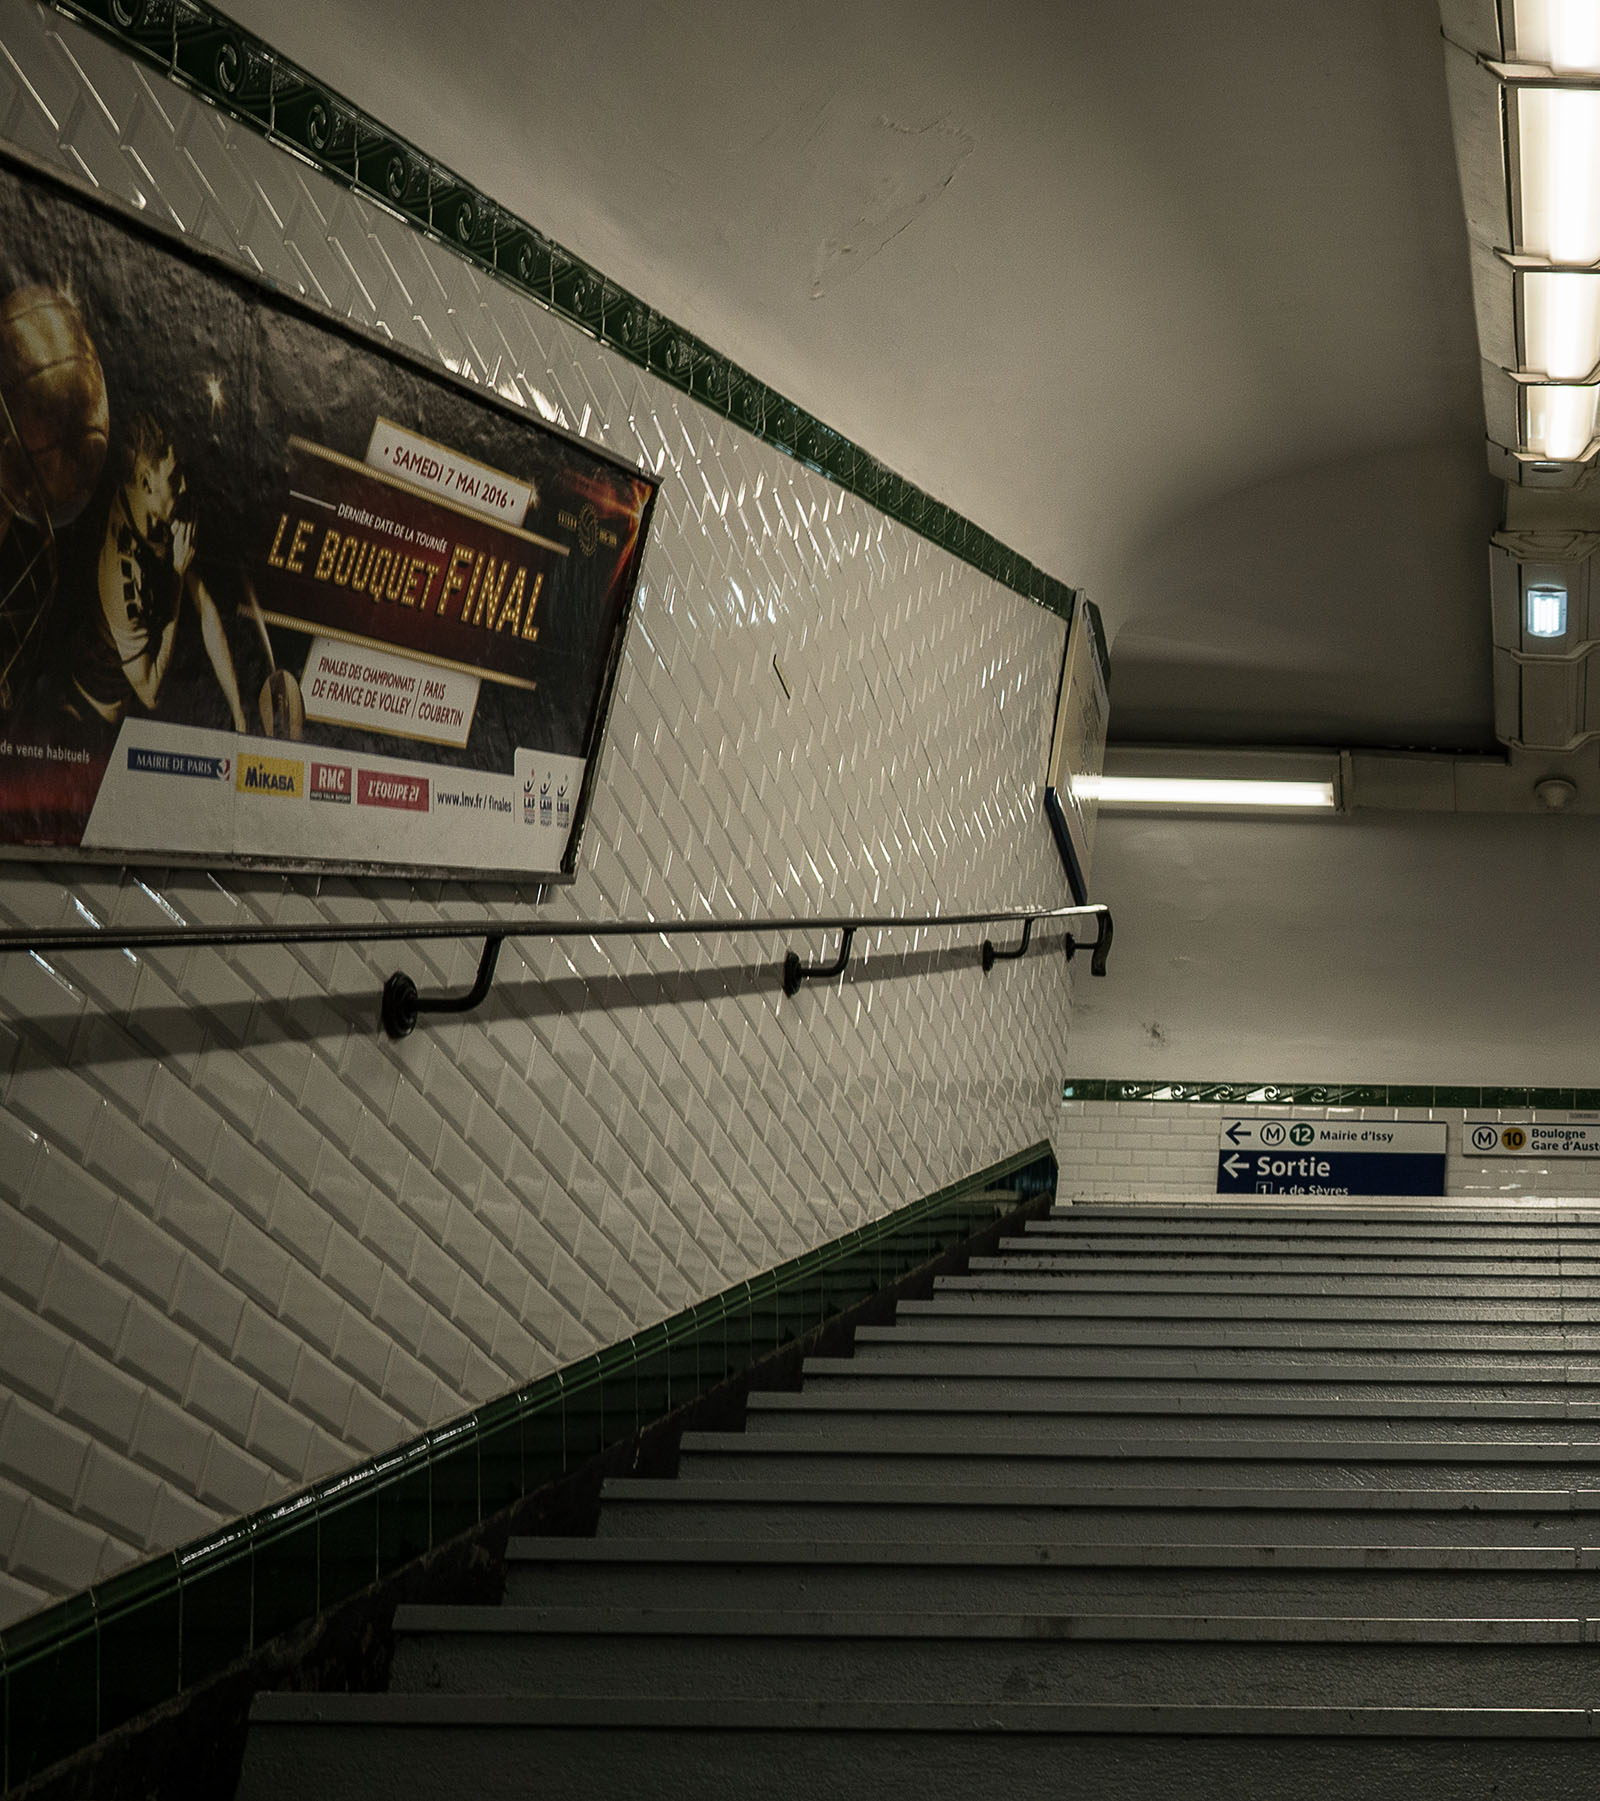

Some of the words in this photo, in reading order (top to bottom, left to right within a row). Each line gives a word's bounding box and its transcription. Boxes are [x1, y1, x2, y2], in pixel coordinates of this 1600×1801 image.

[393, 446, 445, 482] SAMEDI
[445, 468, 455, 486] 7
[455, 473, 481, 498] MAI
[481, 484, 509, 509] 2016
[337, 503, 375, 527] DERNIÈRE
[374, 516, 395, 535] DATE
[394, 523, 405, 538] DE
[405, 528, 415, 542] LA
[415, 530, 449, 554] TOURNÉE
[267, 513, 315, 574] LE
[314, 528, 440, 613] BOUQUET
[436, 543, 545, 642] FINAL
[318, 656, 351, 678] FINALES
[349, 664, 363, 681] DES
[362, 667, 416, 693] CHAMPIONNATS
[311, 678, 327, 698] DE
[327, 681, 363, 707] FRANCE
[364, 689, 379, 709] DE
[378, 692, 412, 715] VOLLEY
[423, 680, 446, 700] PARIS
[418, 702, 465, 727] COUBERTIN
[16, 744, 44, 759] vente
[46, 744, 90, 764] habituels
[136, 754, 169, 769] MAIRIE
[172, 757, 186, 771] DE
[187, 760, 212, 774] PARIS
[319, 766, 345, 790] RMC
[407, 786, 420, 802] 21
[1292, 1127, 1312, 1142] 12
[1320, 1130, 1358, 1141] Mairie
[1361, 1130, 1394, 1143] d'Issy
[1504, 1132, 1523, 1146] 10
[1531, 1128, 1586, 1140] Boulogne
[1531, 1140, 1559, 1151] Gare
[1256, 1156, 1331, 1177] Sortie
[1289, 1185, 1305, 1195] de
[1308, 1185, 1349, 1196] Sèvres
